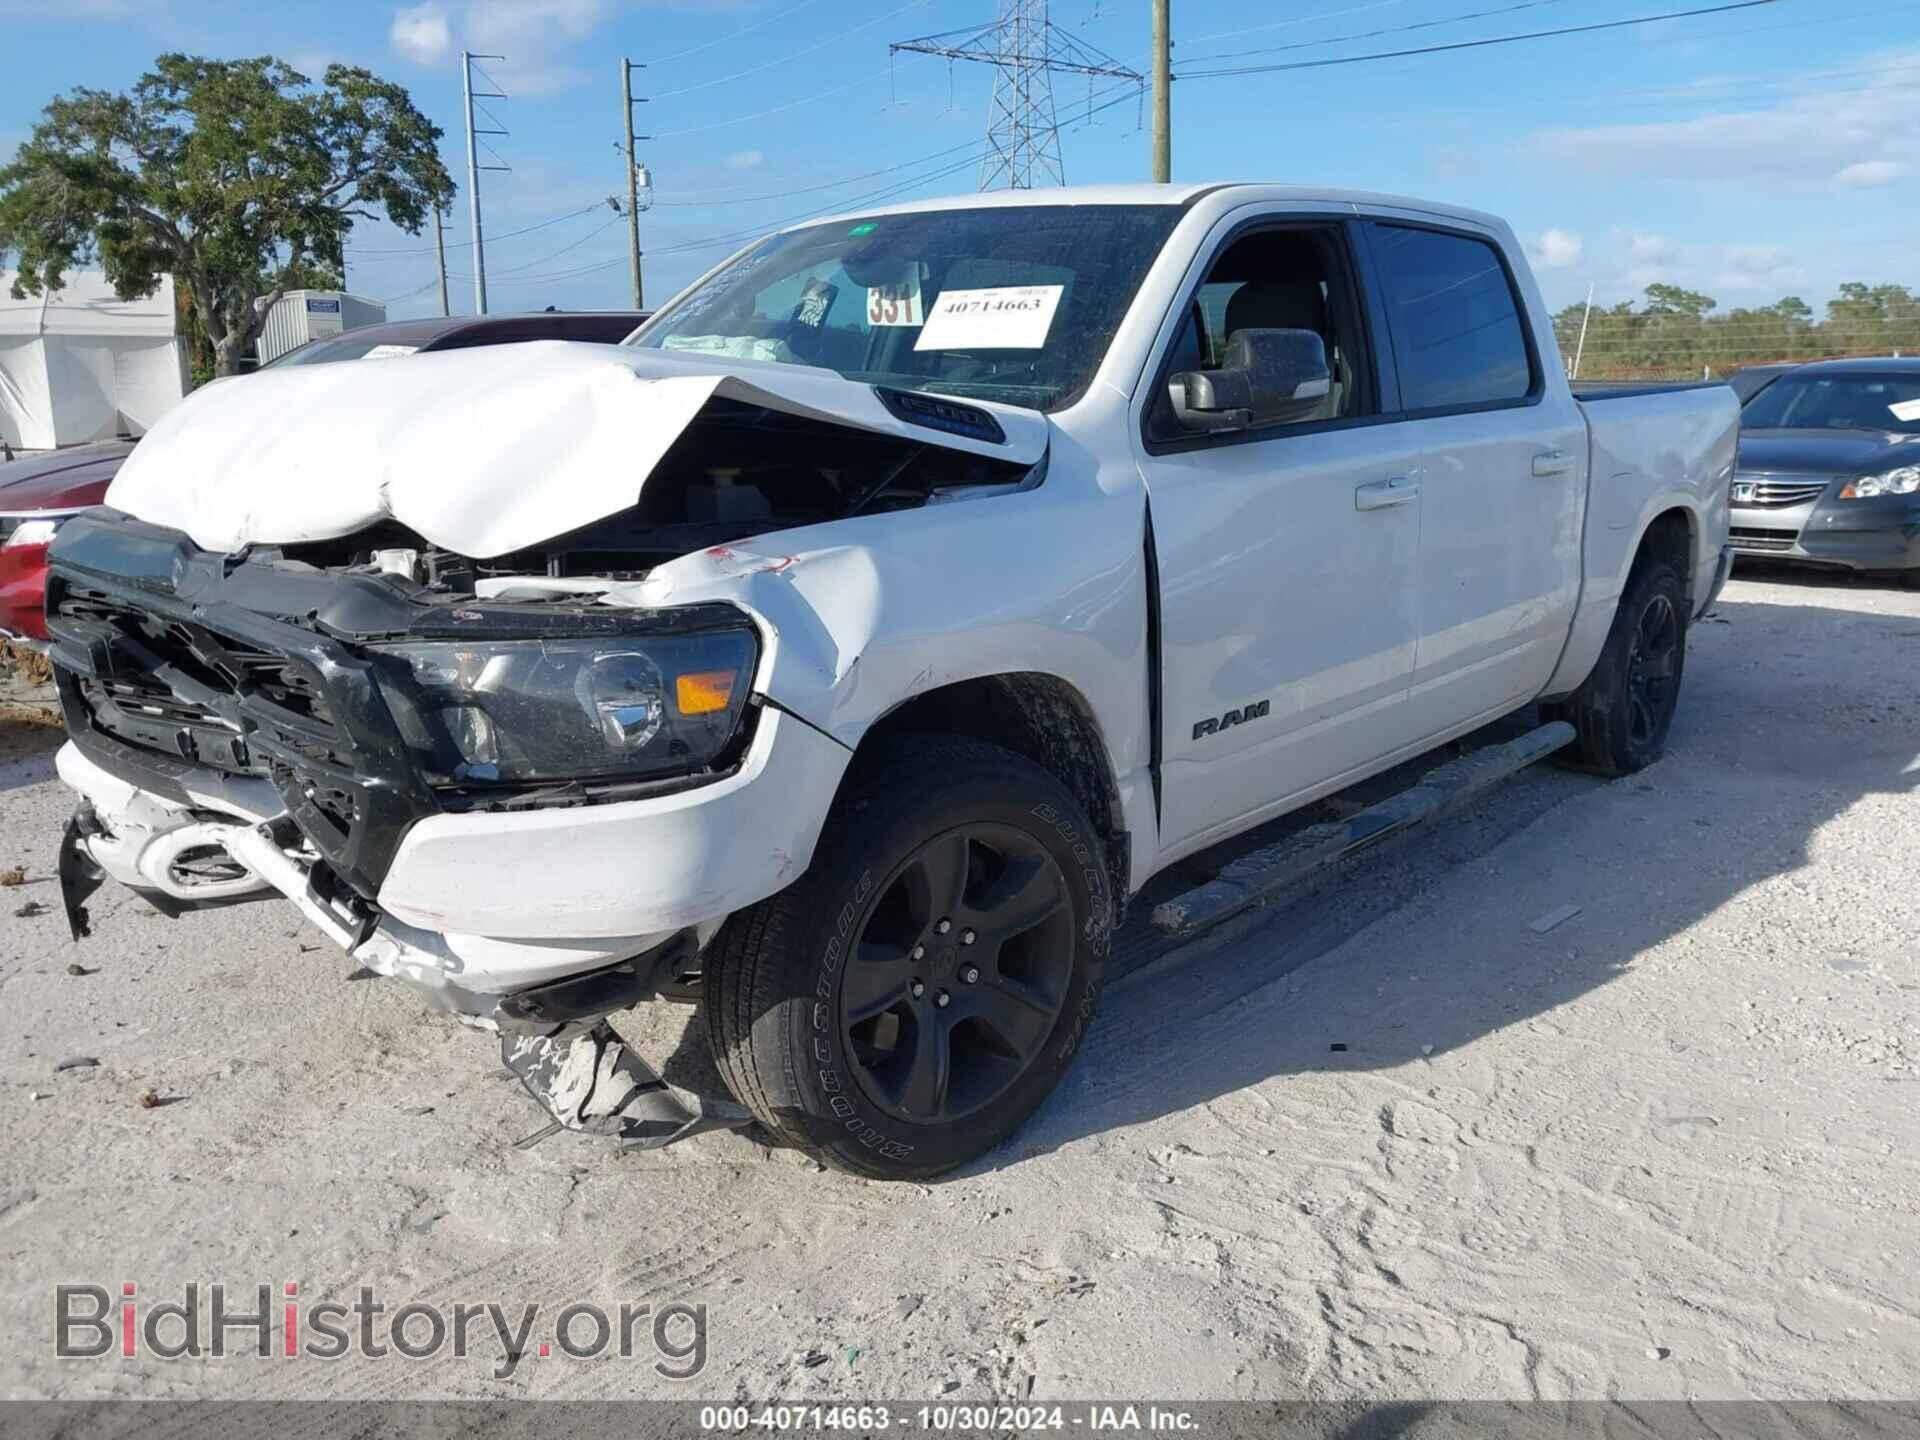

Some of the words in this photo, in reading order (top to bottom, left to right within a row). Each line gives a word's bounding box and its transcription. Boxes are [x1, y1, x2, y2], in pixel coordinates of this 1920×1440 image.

[944, 298, 1042, 314] 40714663
[1192, 699, 1270, 741] RAM
[813, 869, 916, 1161] BRIDGESTONE
